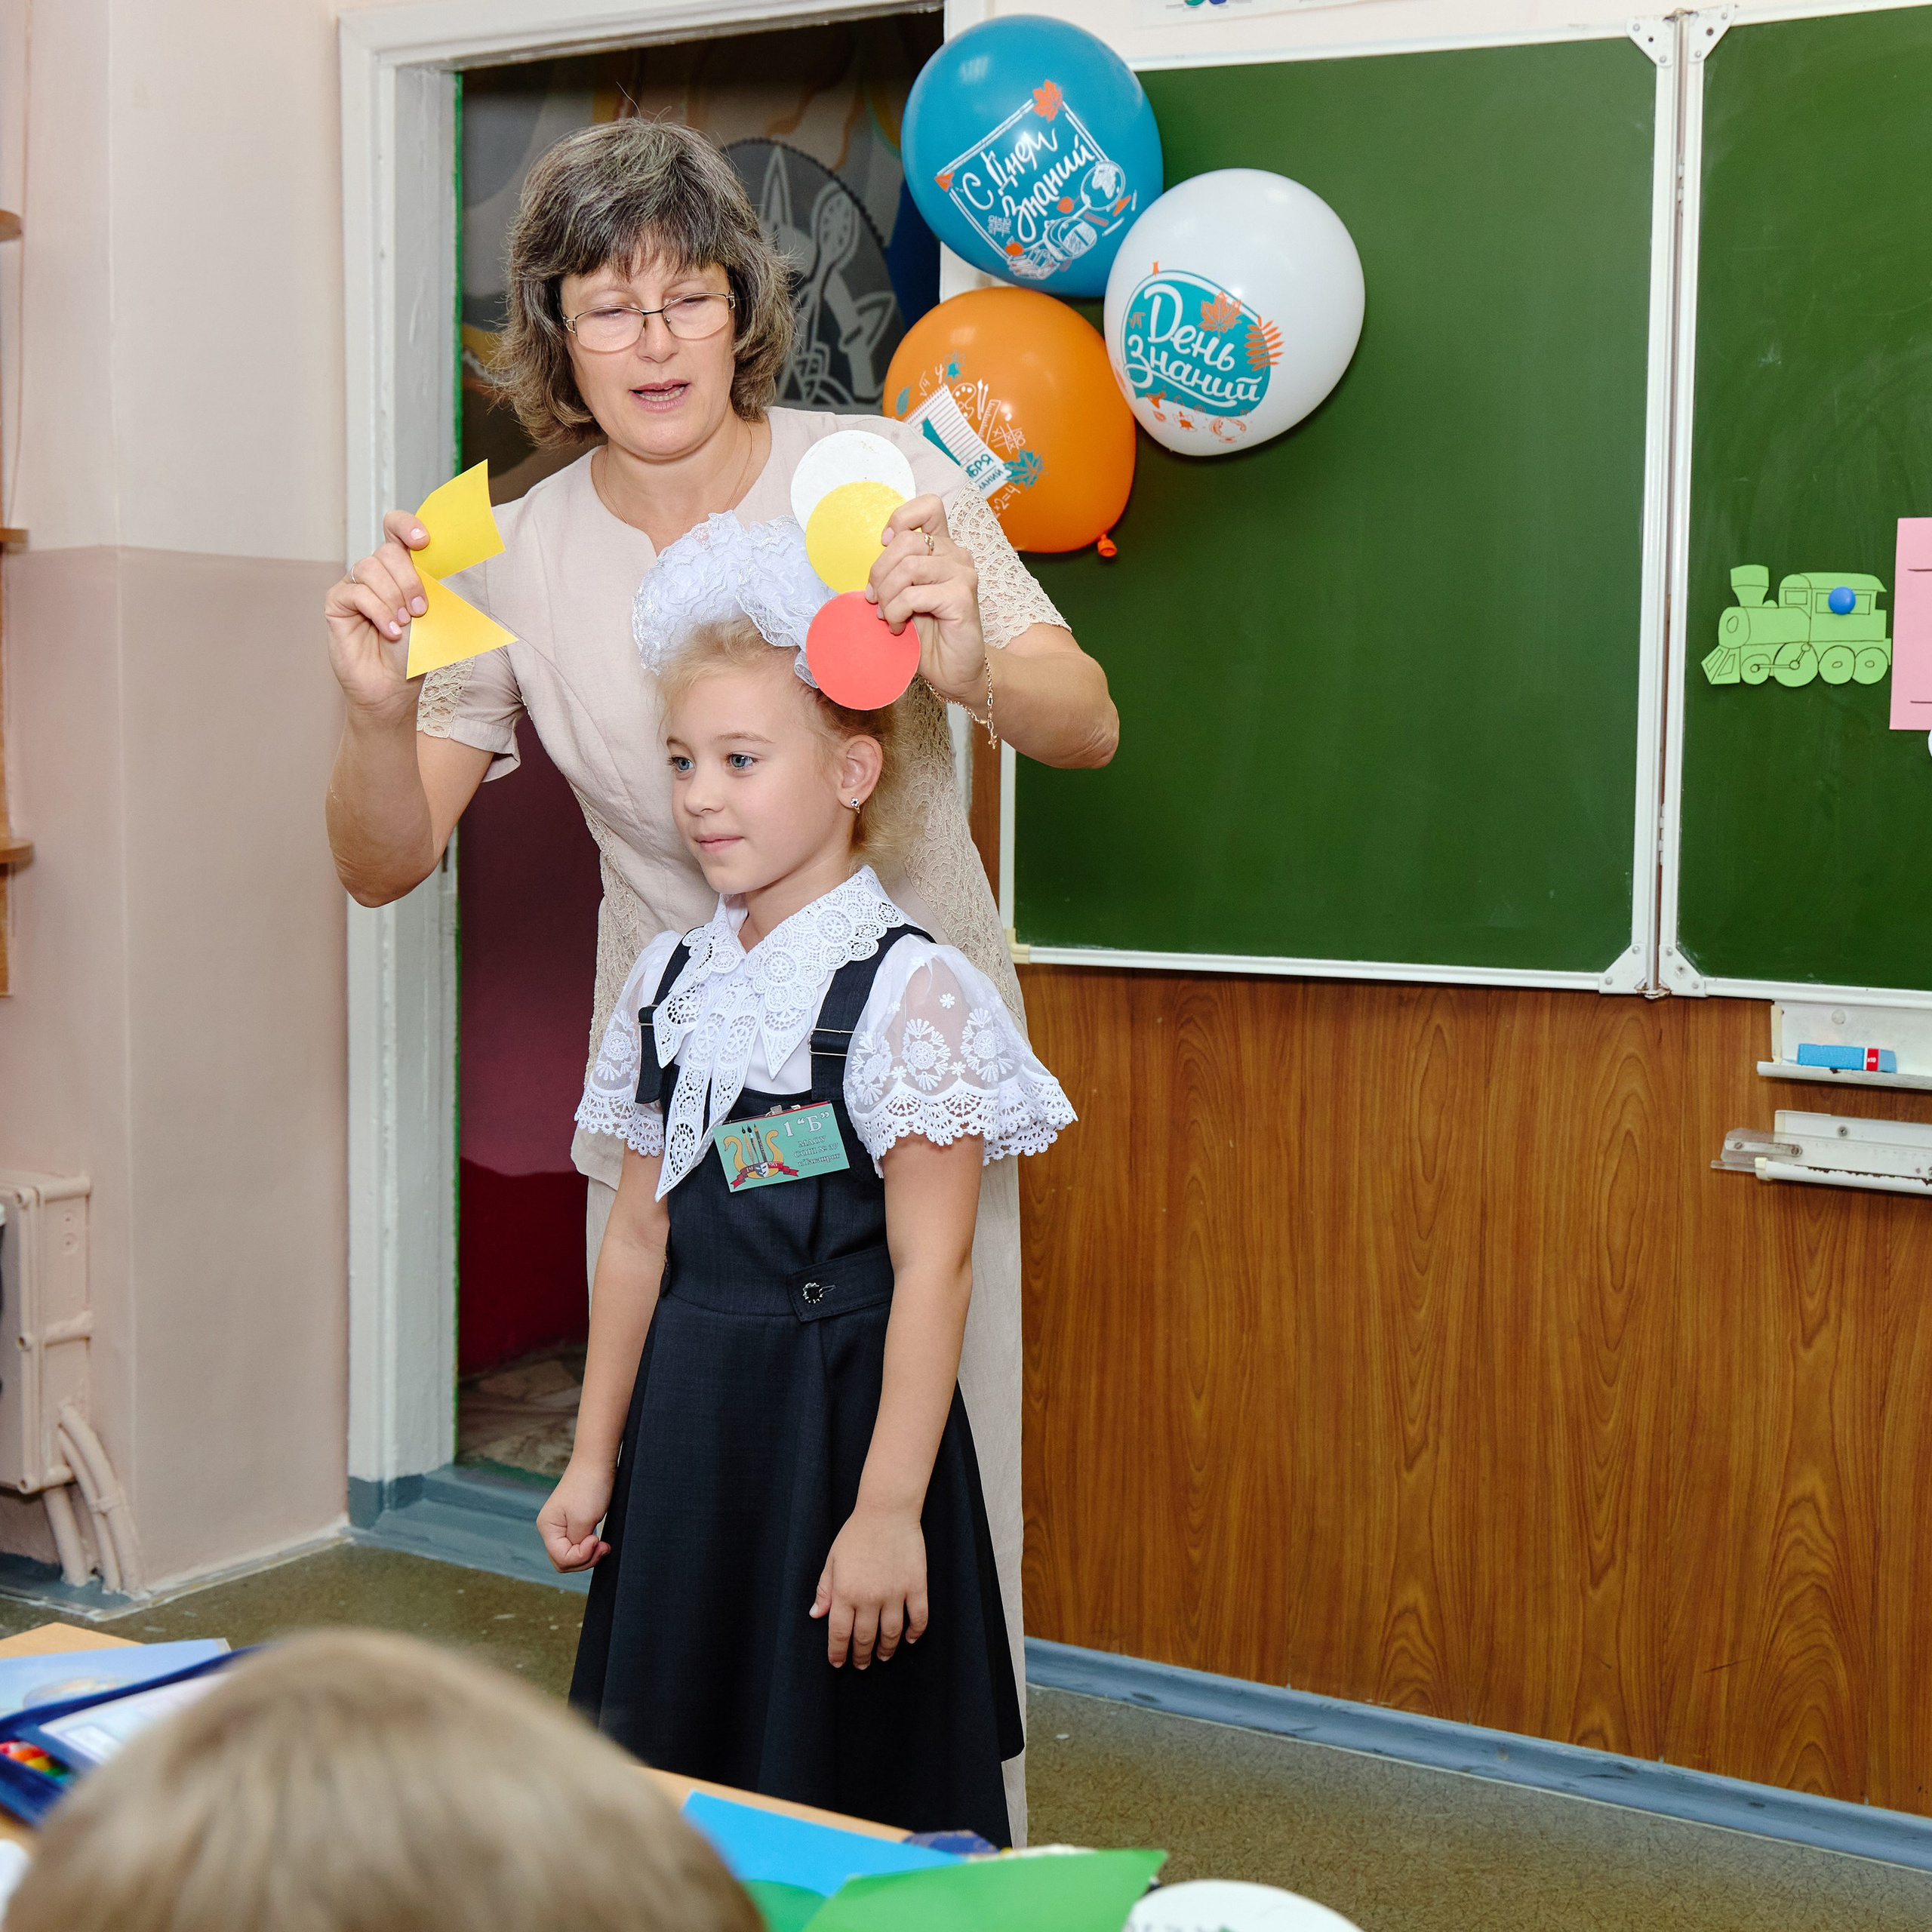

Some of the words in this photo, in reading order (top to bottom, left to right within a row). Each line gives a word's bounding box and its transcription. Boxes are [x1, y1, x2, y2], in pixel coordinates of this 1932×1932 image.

[962, 172, 995, 211] С
[1143, 283, 1235, 371] День
[1124, 334, 1263, 408] Знаний
[783, 1121, 794, 1137] 1
[794, 1147, 817, 1158] СОШ
